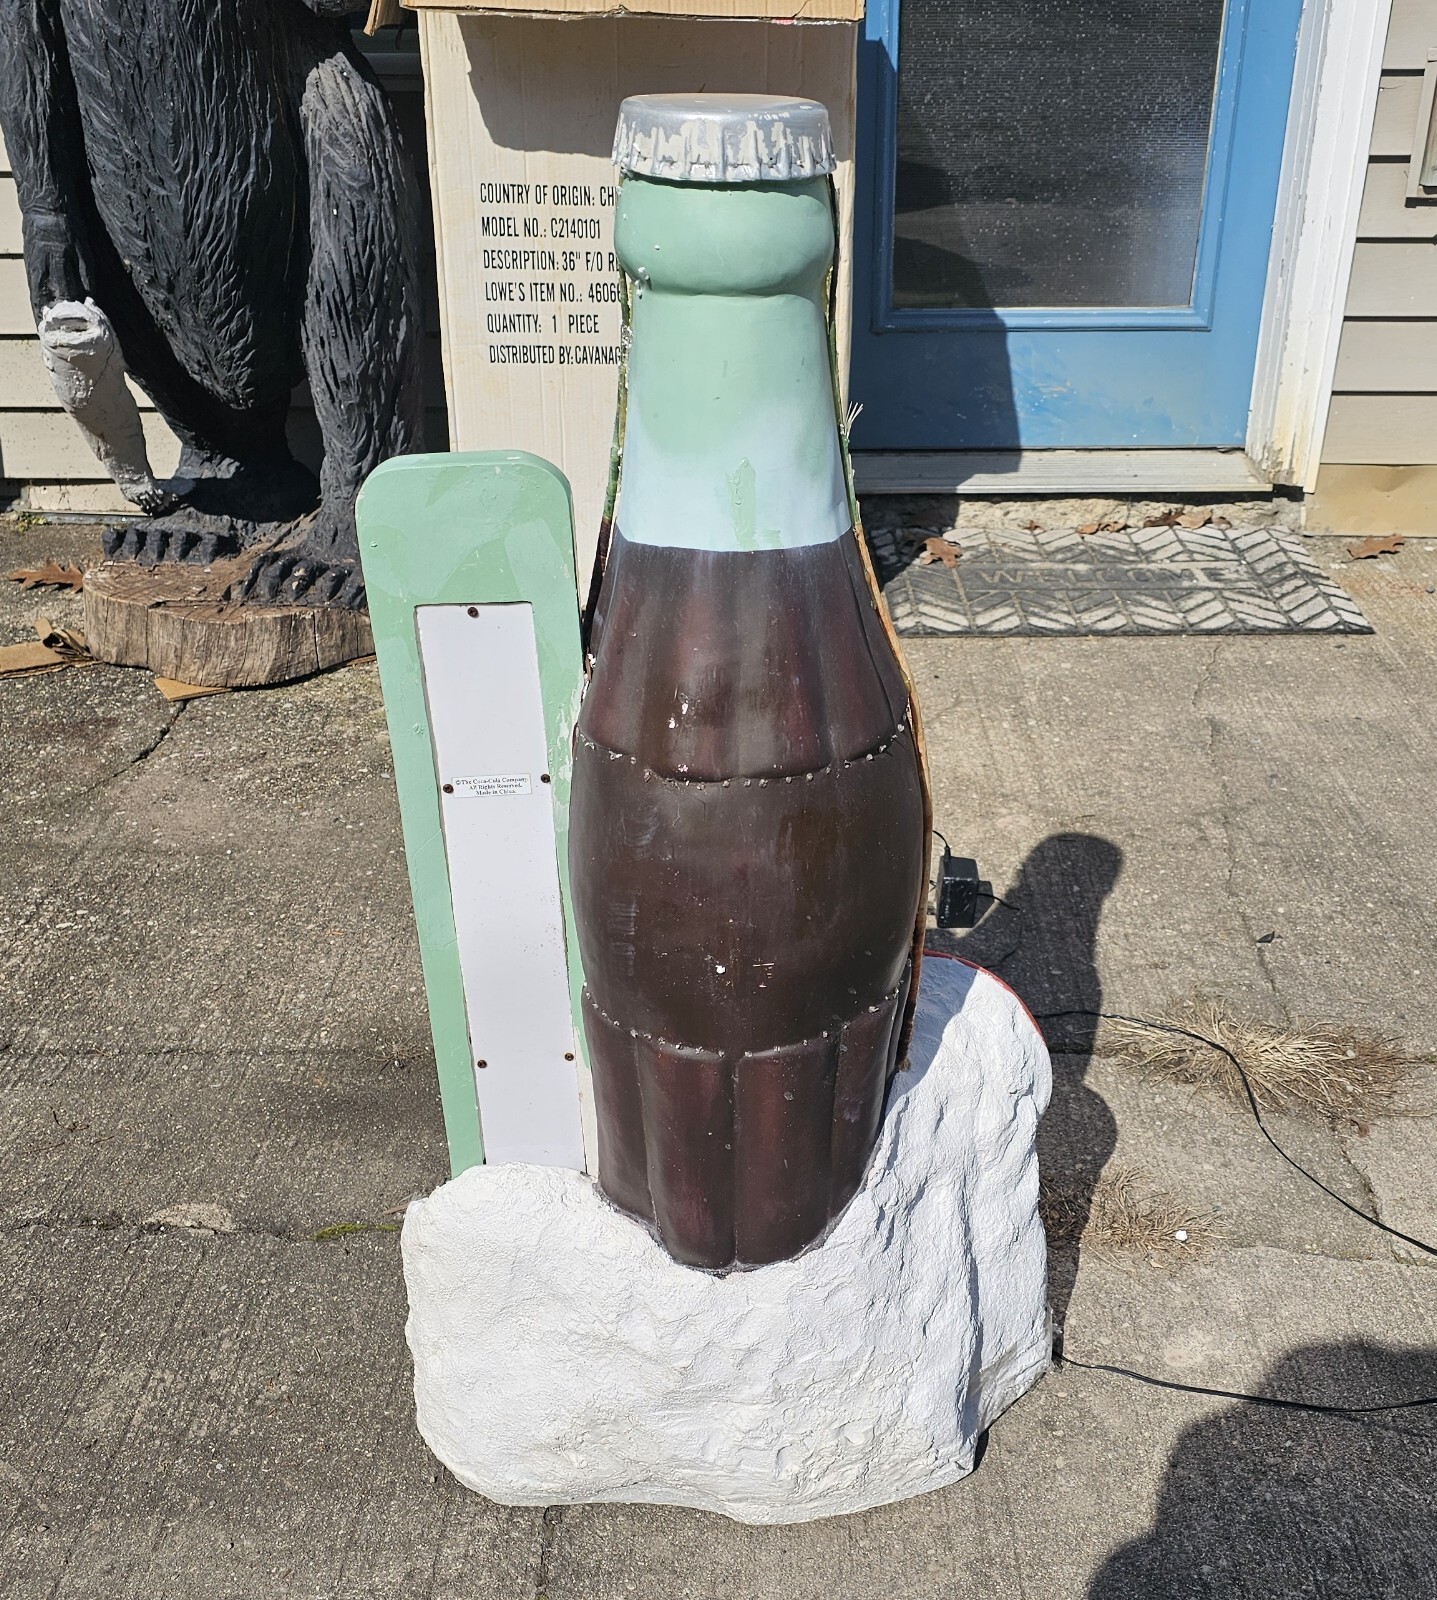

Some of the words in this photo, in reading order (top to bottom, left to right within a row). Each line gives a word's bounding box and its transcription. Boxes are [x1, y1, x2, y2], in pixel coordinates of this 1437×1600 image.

[481, 183, 530, 204] COUNTRY
[536, 185, 547, 204] OF
[553, 185, 594, 206] ORIGIN:
[600, 186, 616, 206] CH
[482, 217, 519, 236] MODEL
[524, 218, 546, 237] NO.:
[551, 218, 600, 239] C2140101
[484, 250, 558, 270] DESCRIPTION:
[562, 251, 580, 271] 36"
[586, 252, 602, 271] F/O
[486, 282, 525, 301] LOWE'S
[530, 283, 554, 301] ITEM
[560, 283, 582, 302] NO.:
[488, 314, 541, 333] QUANTITY:
[552, 314, 557, 333] 1
[569, 315, 599, 333] PIECE
[490, 345, 554, 363] DISTRIBUTED
[978, 567, 1230, 583] WELCOME
